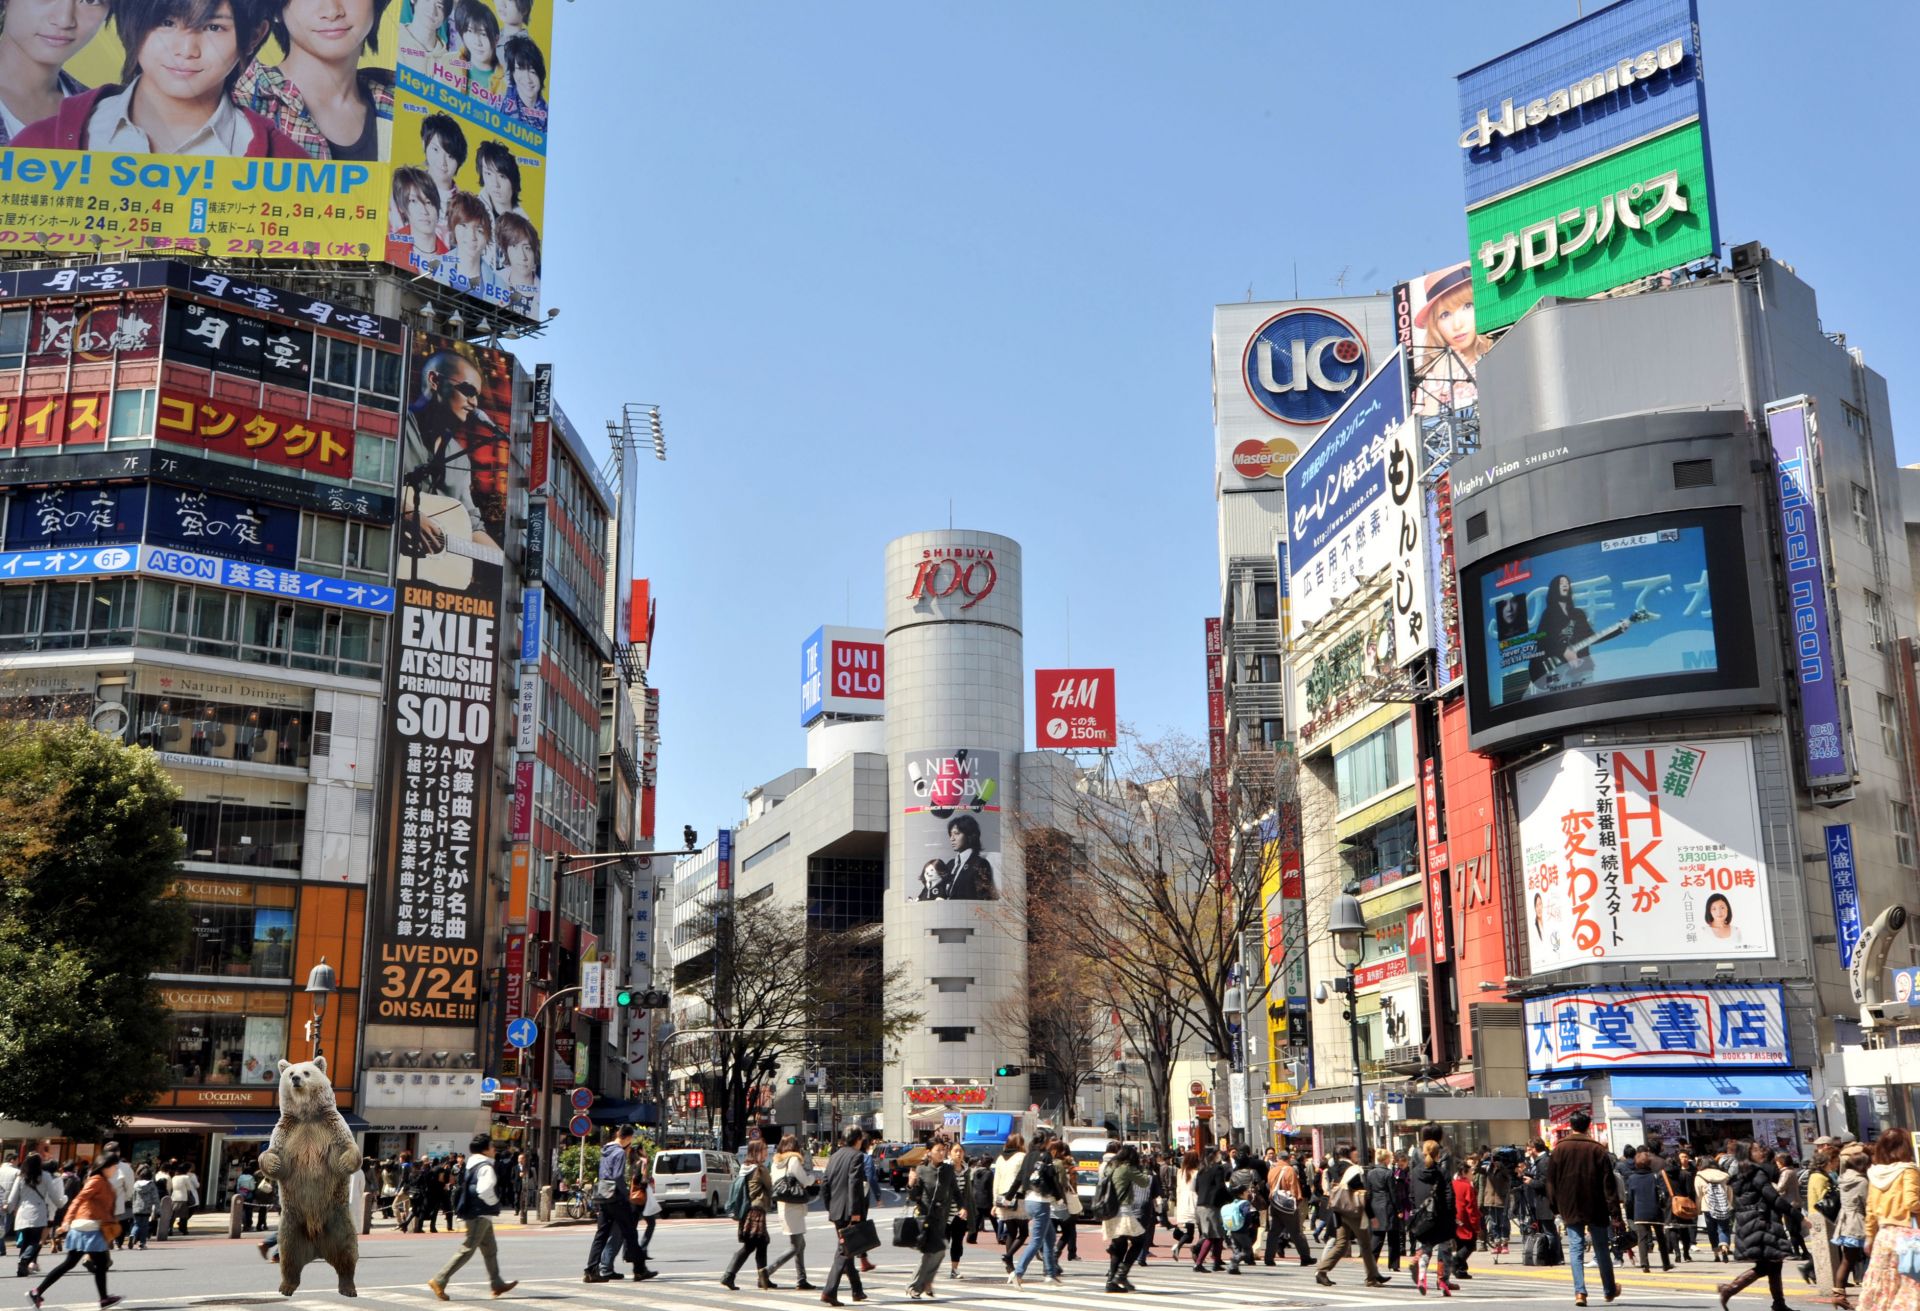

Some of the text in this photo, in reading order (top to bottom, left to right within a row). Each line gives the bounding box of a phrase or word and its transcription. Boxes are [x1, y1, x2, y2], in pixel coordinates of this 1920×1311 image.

[433, 62, 467, 89] Hey!
[471, 80, 502, 107] Say!
[1458, 37, 1684, 149] Hisamitsu
[400, 69, 544, 147] Hey! Say! JUMP
[0, 151, 369, 197] Hey! Say! JUMP
[209, 202, 257, 215] 横浜アリーナ
[207, 221, 289, 237] 大阪ドーム 16日
[1477, 169, 1688, 284] サロンパス
[409, 252, 444, 277] Hey!
[485, 283, 513, 304] BES
[187, 304, 206, 316] 9F
[159, 396, 347, 464] コンタクト
[123, 457, 139, 470] 7F
[160, 459, 178, 472] 7F
[1453, 446, 1569, 499] Mighty Vision SHIBUYA
[922, 548, 994, 560] SHIBUYA
[1303, 504, 1390, 598] 広告用不燃素
[1388, 438, 1422, 645] もんじゃ
[3, 554, 88, 575] イーオン
[101, 553, 123, 568] 6F
[148, 550, 218, 581] AEON
[529, 568, 540, 576] 7F
[1778, 446, 1824, 685] Taisei neon
[229, 562, 389, 607] 英会話イーオン
[906, 558, 998, 610] 109
[404, 586, 495, 618] EXH SPECIAL
[401, 605, 494, 659] EXILE
[400, 648, 492, 685] ATSUSHI
[806, 641, 818, 672] THE
[838, 648, 877, 667] UNI
[26, 676, 68, 689] Dining
[181, 678, 288, 703] Natural Dining
[398, 674, 491, 702] PREMIUM LIVE
[802, 672, 821, 714] PRIME
[838, 673, 881, 694] QLO
[1052, 678, 1099, 709] H&M
[396, 692, 490, 745] SOLO
[521, 680, 534, 746] 渋谷駅前ビル
[1070, 717, 1097, 727] この先
[1071, 727, 1107, 739] 150m
[517, 762, 533, 772] 5F
[925, 757, 979, 776] NEW!
[1810, 747, 1840, 760] 2468
[1662, 747, 1698, 798] 速報
[914, 779, 989, 798] GATSBY
[396, 743, 423, 937] 番組では未放送楽曲を収録
[415, 744, 438, 937] カヴァー曲がラインナップ
[430, 746, 453, 939] ATSUSHIだから可能な
[445, 748, 475, 939] 収録曲全てが名曲
[1594, 752, 1624, 947] ドラマ新番組、続々スタート
[1561, 808, 1605, 958] 変わる。
[1680, 867, 1756, 891] よる10時
[636, 890, 650, 963] 洋装生地
[382, 944, 478, 966] LIVE DVD
[380, 964, 477, 1000] 3/24
[161, 991, 233, 1005] L'OCCITANE
[379, 1000, 476, 1020] ON SALE!!!
[1533, 1001, 1769, 1056] 大盛堂書店
[1722, 1051, 1783, 1061] BOOKS TAISEIDO
[198, 1091, 253, 1102] L'OCCITANE
[1683, 1100, 1739, 1109] TAISEIDO
